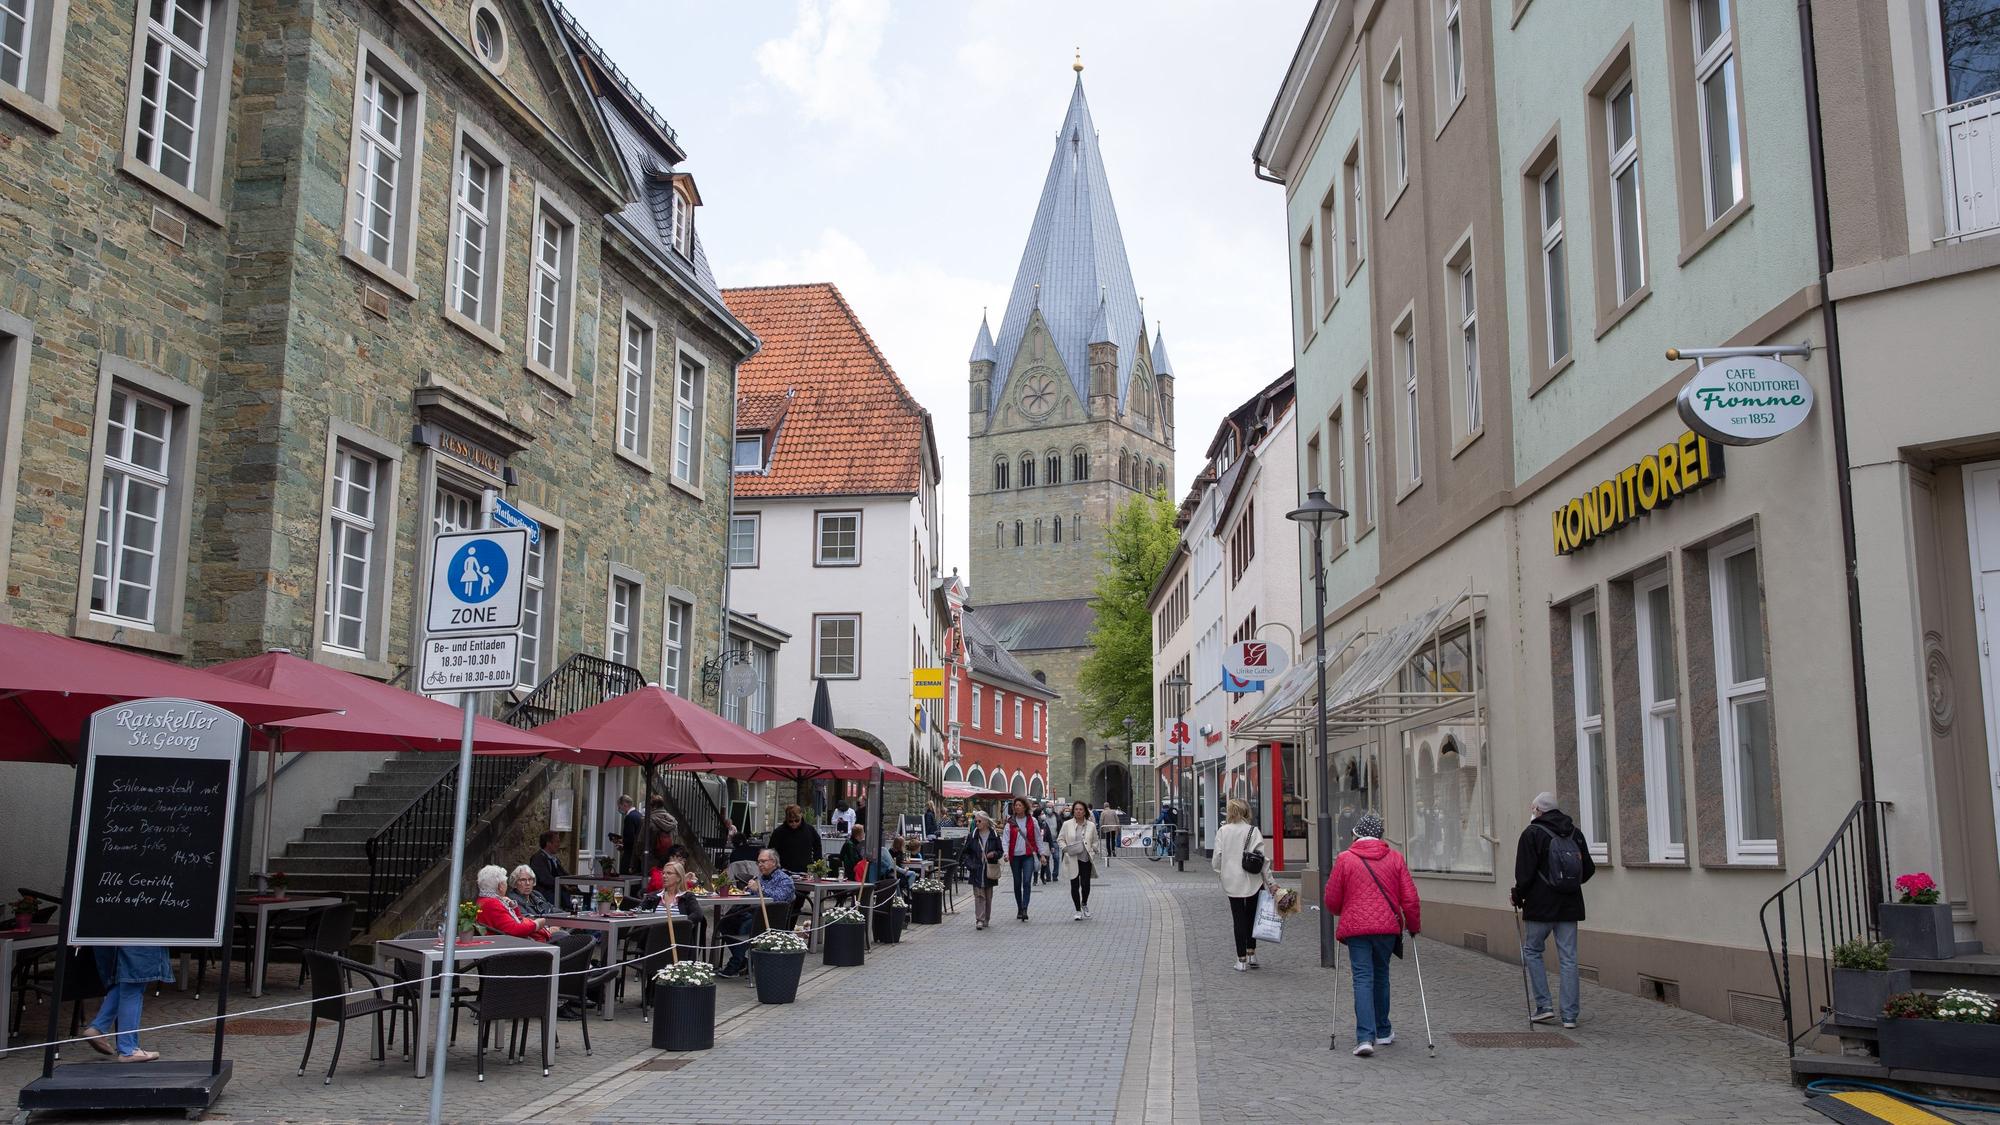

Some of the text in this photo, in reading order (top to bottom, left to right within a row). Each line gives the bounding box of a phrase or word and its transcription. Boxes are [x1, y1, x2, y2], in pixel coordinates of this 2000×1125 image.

[1726, 369, 1755, 380] CAFE
[1728, 380, 1799, 393] KONDITOREI
[1696, 387, 1806, 411] Fromme
[1731, 413, 1776, 425] SEIT 1852
[441, 431, 499, 472] RESSOURCE
[1552, 429, 1710, 556] KONDITOREI
[451, 606, 498, 625] ZONE
[434, 639, 506, 653] Be- und Entladen
[441, 653, 497, 667] 18.30-10.30 h
[449, 672, 463, 683] frei
[116, 709, 218, 733] Ratskeller
[102, 819, 134, 834] Sauce
[202, 851, 216, 865] €
[98, 871, 123, 887] Alle
[95, 890, 191, 909] auch außer Haus
